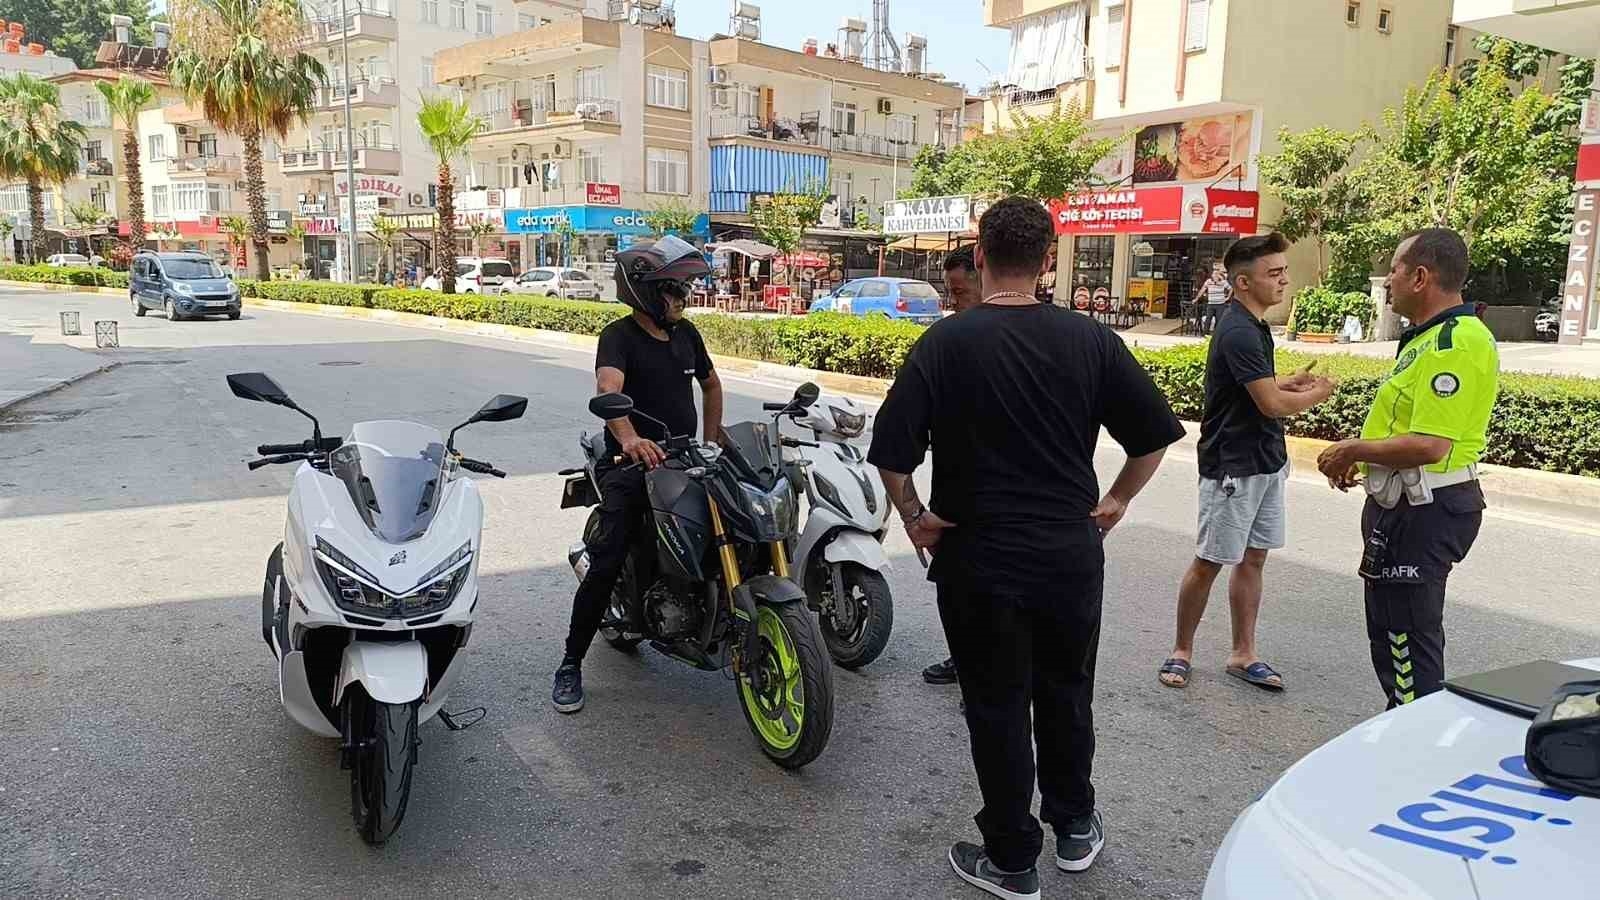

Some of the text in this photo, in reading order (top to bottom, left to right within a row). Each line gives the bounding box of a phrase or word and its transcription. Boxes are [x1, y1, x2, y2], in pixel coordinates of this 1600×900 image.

[906, 198, 947, 217] KAYA
[519, 211, 537, 225] eda
[887, 213, 966, 232] KAHVEHANESİ
[1562, 193, 1595, 337] ECZANE
